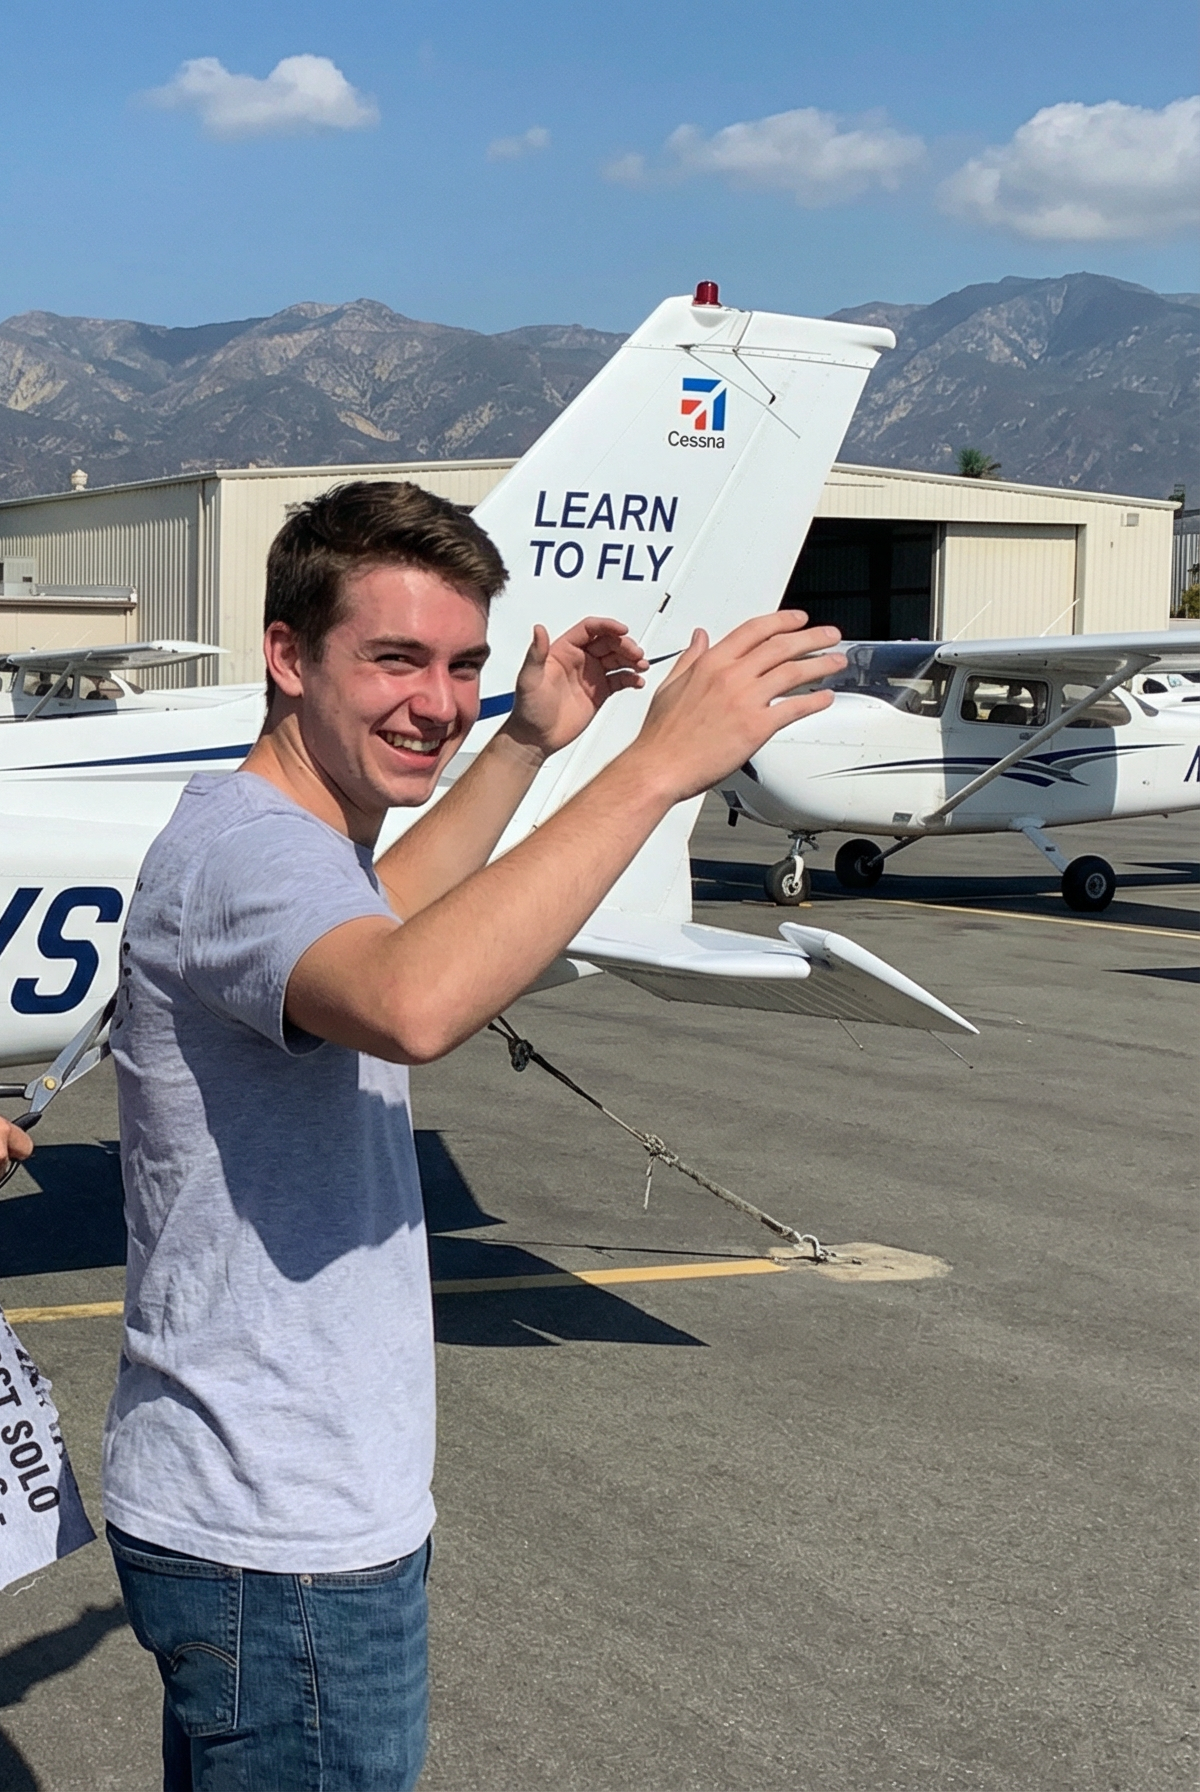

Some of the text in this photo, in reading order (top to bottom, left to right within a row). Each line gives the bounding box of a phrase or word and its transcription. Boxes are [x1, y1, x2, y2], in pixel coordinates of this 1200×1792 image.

[667, 431, 725, 449] Cessna
[534, 490, 679, 533] LEARN
[529, 540, 675, 582] TO FLY
[0, 1420, 61, 1513] SOLO
